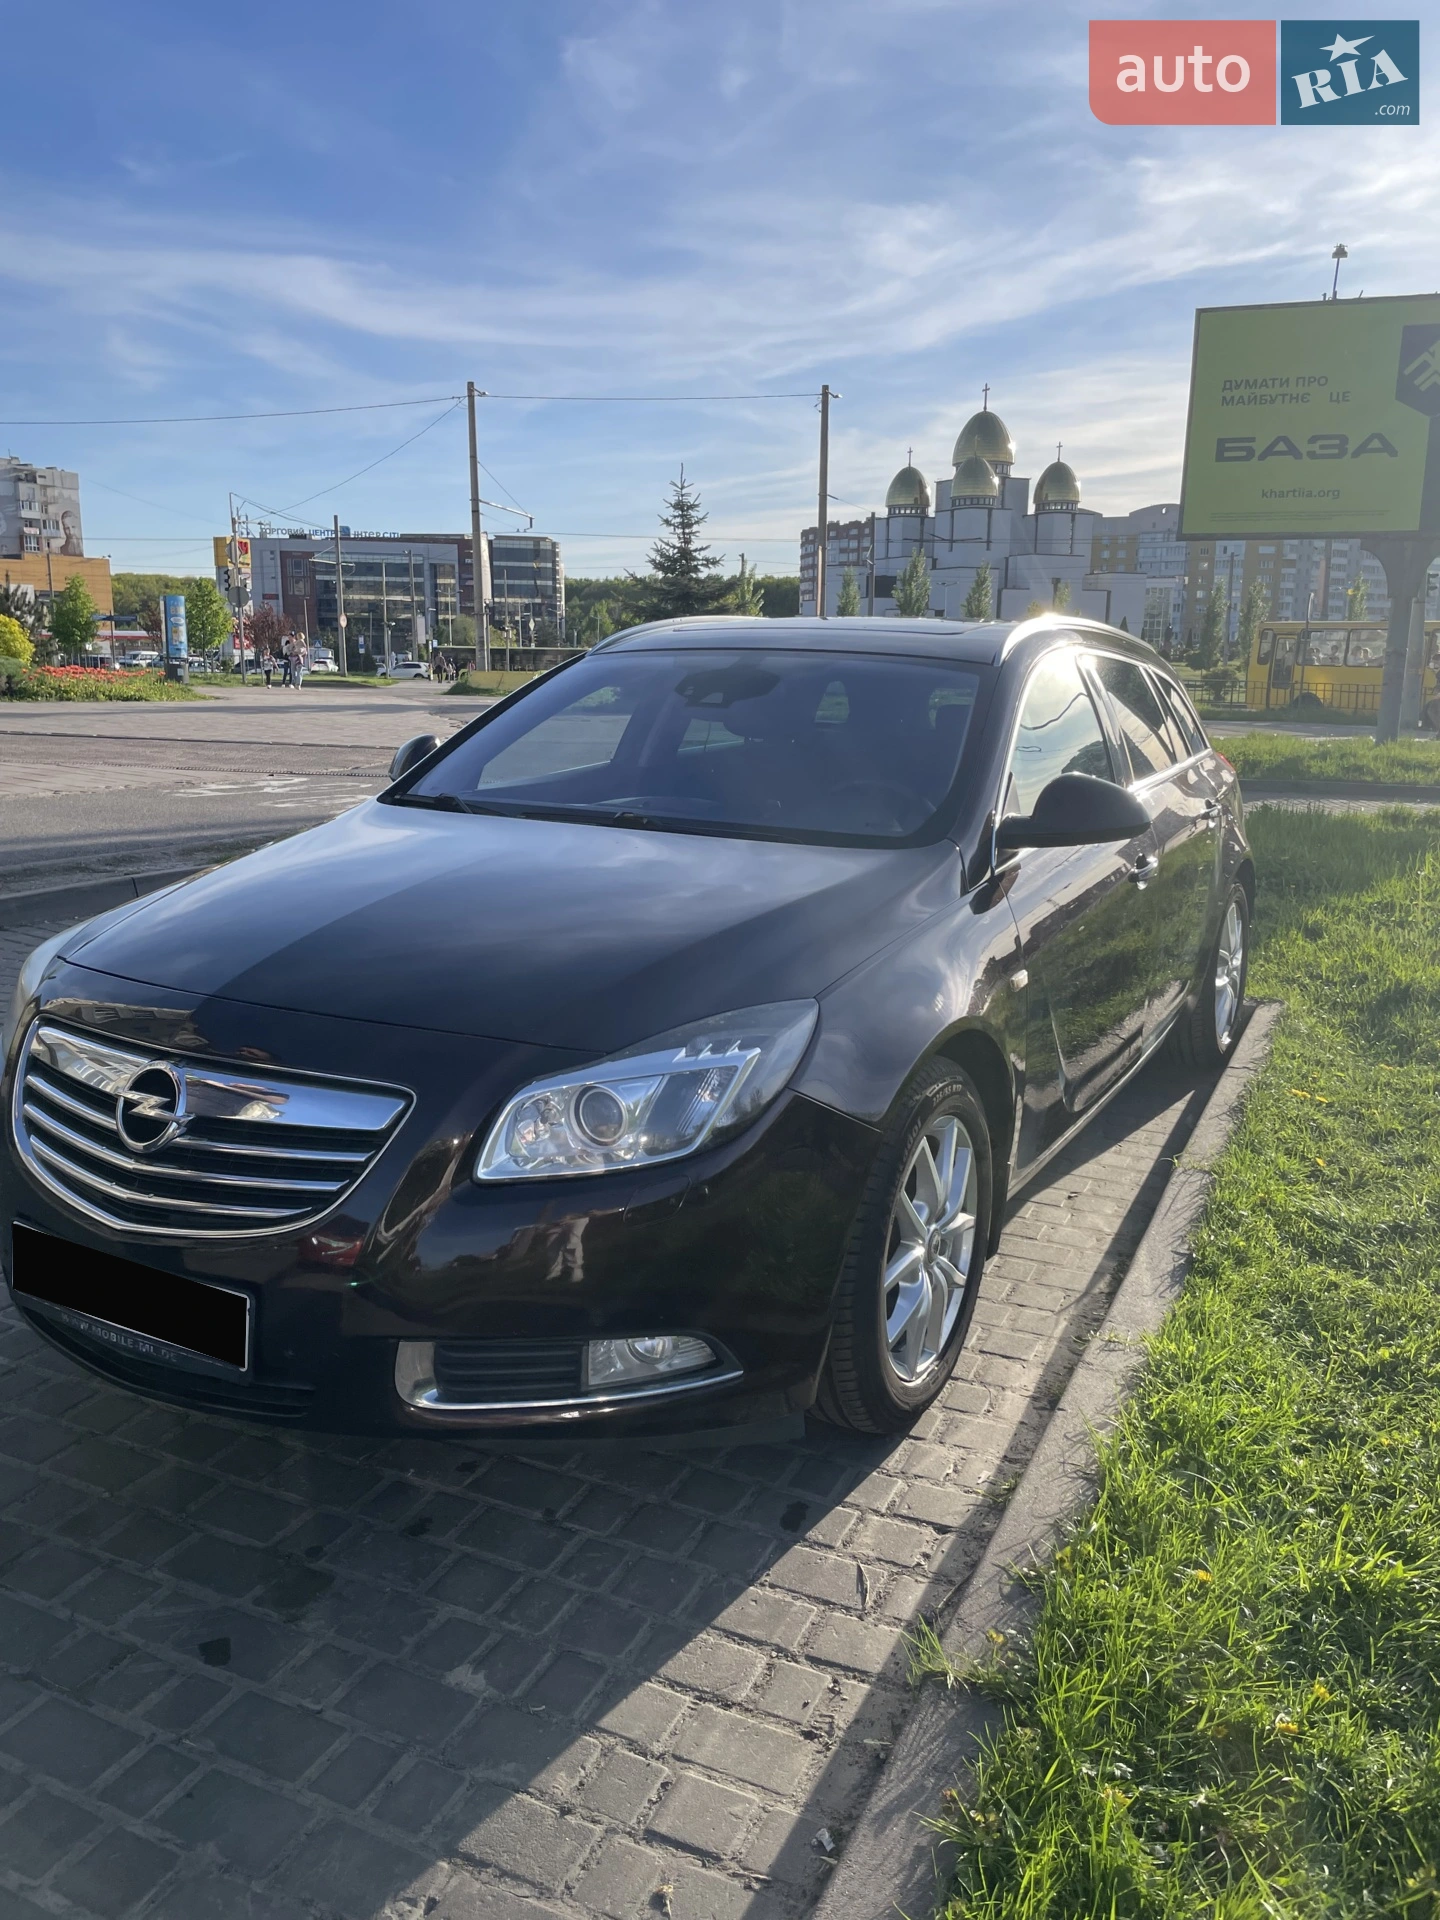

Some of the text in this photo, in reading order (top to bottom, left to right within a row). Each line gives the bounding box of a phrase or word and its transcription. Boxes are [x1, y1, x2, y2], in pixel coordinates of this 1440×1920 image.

[1222, 375, 1329, 393] ДУМАТИ ПРО
[1221, 391, 1351, 407] МАЙБУТНЄ ЦЕ
[1215, 432, 1398, 462] БАЗА
[1261, 488, 1341, 499] khartiia.org
